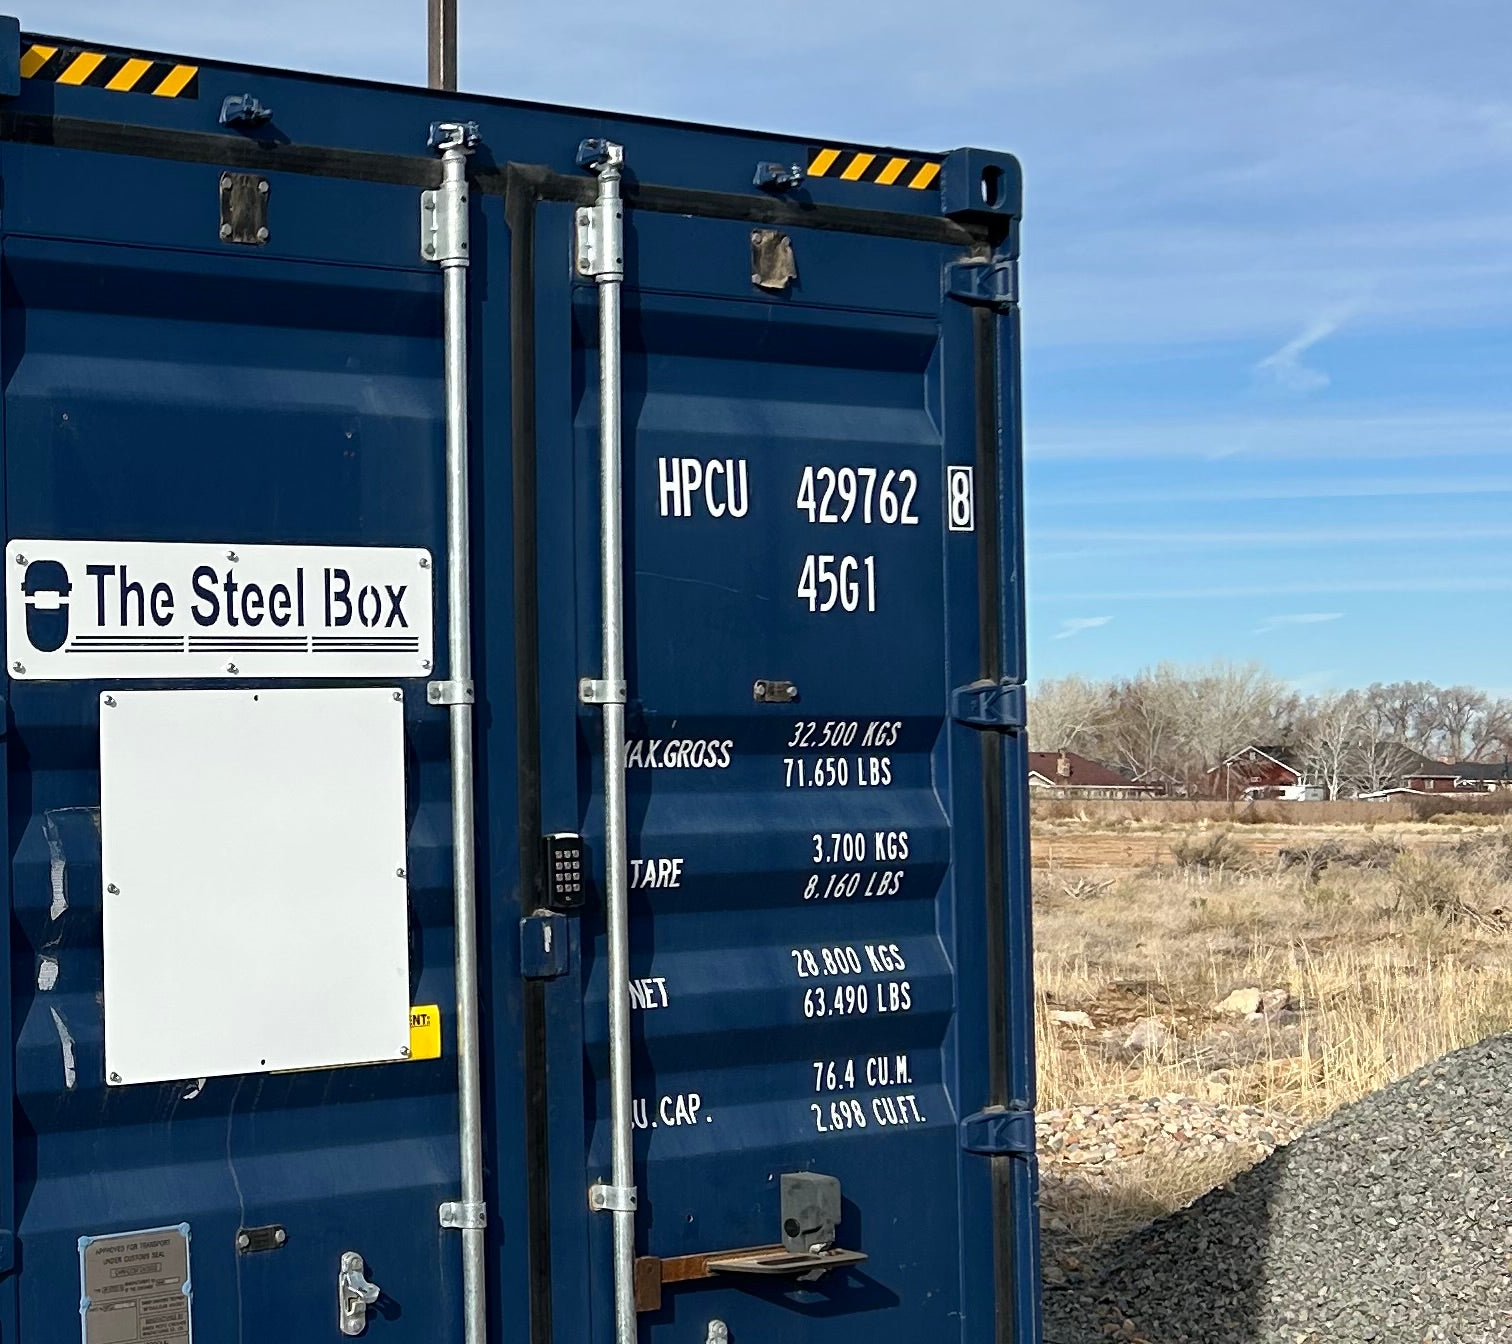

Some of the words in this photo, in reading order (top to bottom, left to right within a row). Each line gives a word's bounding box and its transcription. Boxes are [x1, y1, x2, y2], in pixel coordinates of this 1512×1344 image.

[658, 457, 748, 518] HPCU
[796, 466, 919, 525] 429762
[950, 470, 972, 528] 8
[86, 564, 174, 627] The
[191, 565, 304, 627] Steel
[324, 567, 409, 628] Box
[797, 555, 876, 612] 45G1
[788, 721, 855, 747] 32.500
[862, 721, 902, 747] KGS
[784, 758, 848, 787] 71.650
[858, 758, 891, 786] LBS
[813, 833, 865, 863] 3.700
[875, 832, 909, 860] KGS
[631, 858, 683, 888] TARE
[803, 873, 860, 899] 8.160
[865, 871, 903, 897] LBS
[792, 946, 861, 978] 28.800
[865, 944, 905, 972] KGS
[629, 977, 669, 1009] NET
[804, 988, 868, 1018] 63.490
[877, 982, 911, 1012] LBS
[814, 1059, 854, 1092] 76.4
[866, 1055, 912, 1086] CU.M.
[632, 1093, 712, 1128] U.CAP.
[811, 1099, 866, 1132] 2.698
[873, 1095, 926, 1126] CU.FT.
